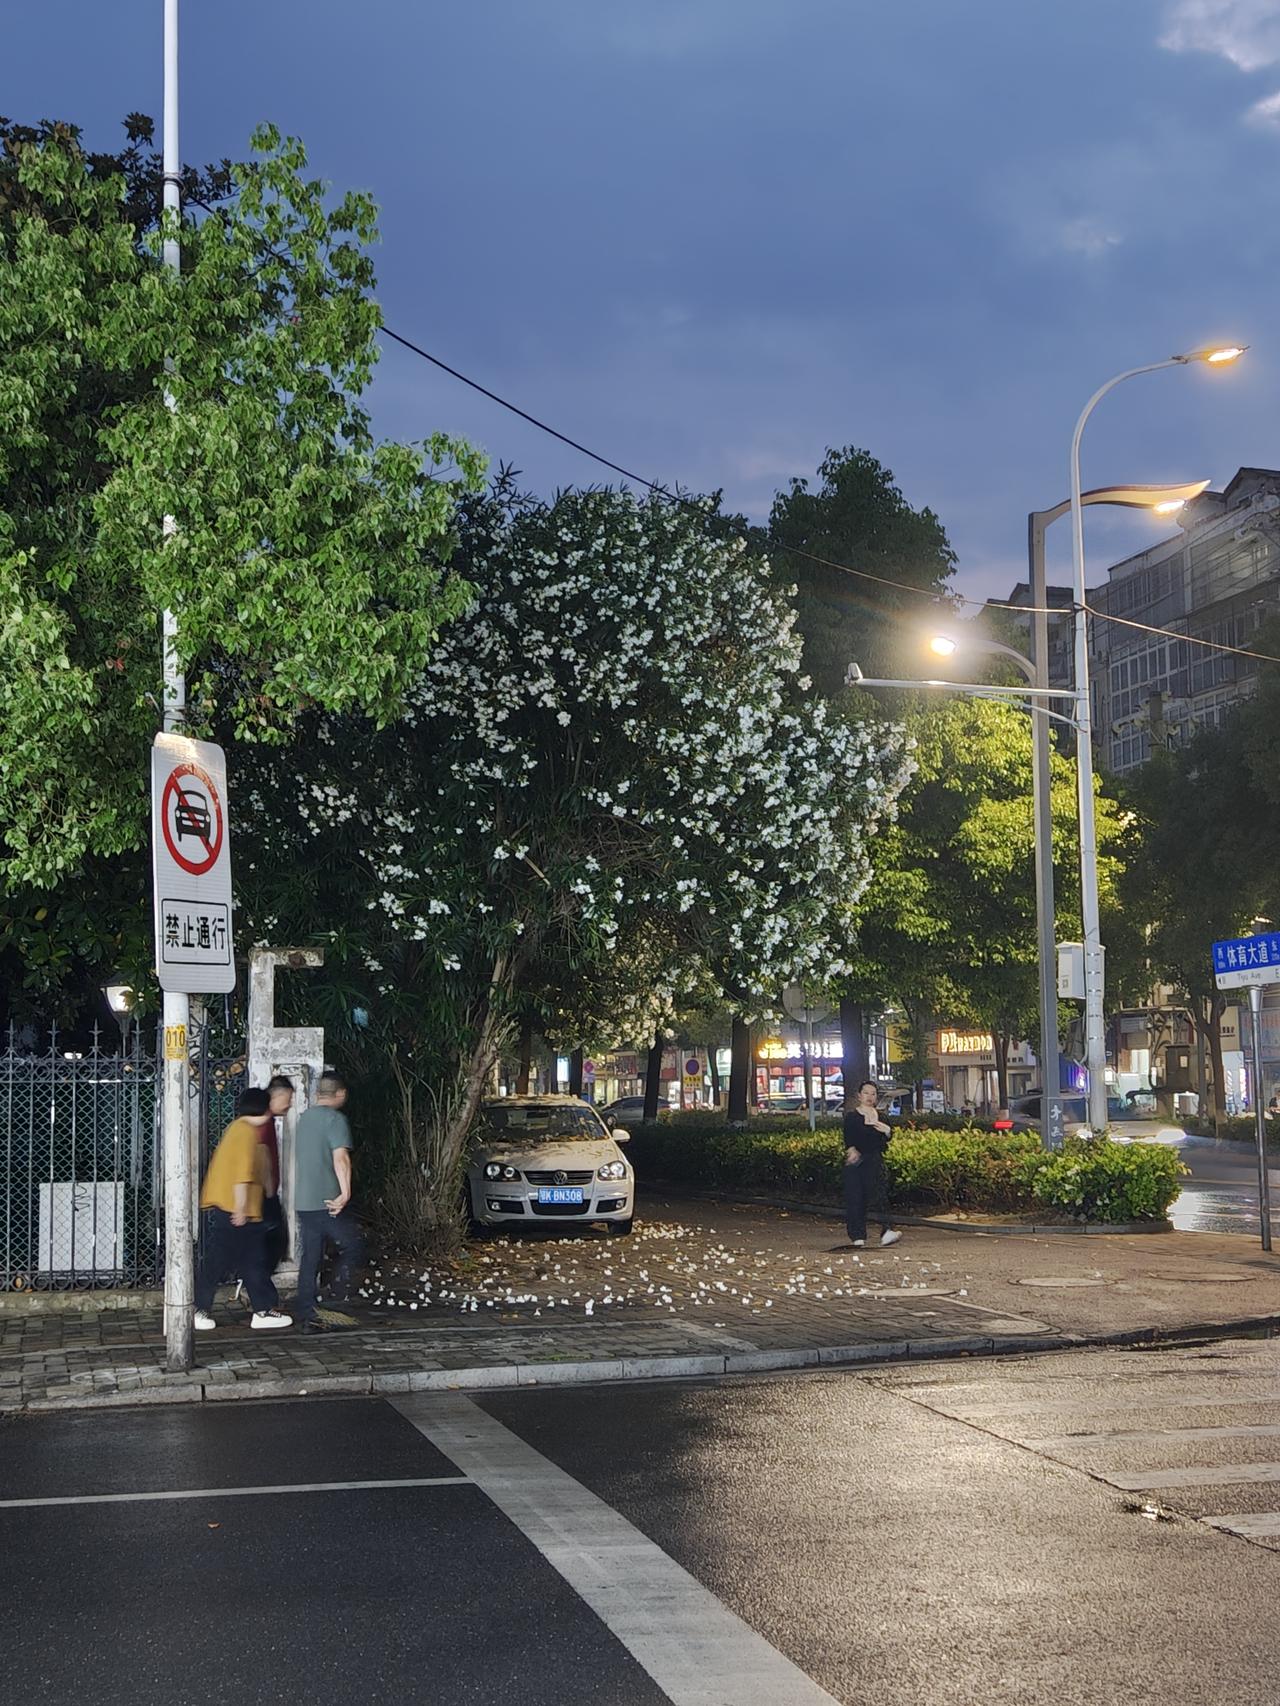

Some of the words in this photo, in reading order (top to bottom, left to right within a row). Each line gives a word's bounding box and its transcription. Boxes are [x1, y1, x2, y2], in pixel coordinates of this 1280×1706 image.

[165, 914, 225, 950] 禁止通行
[1227, 941, 1269, 967] 体育大道
[166, 1030, 185, 1047] 010
